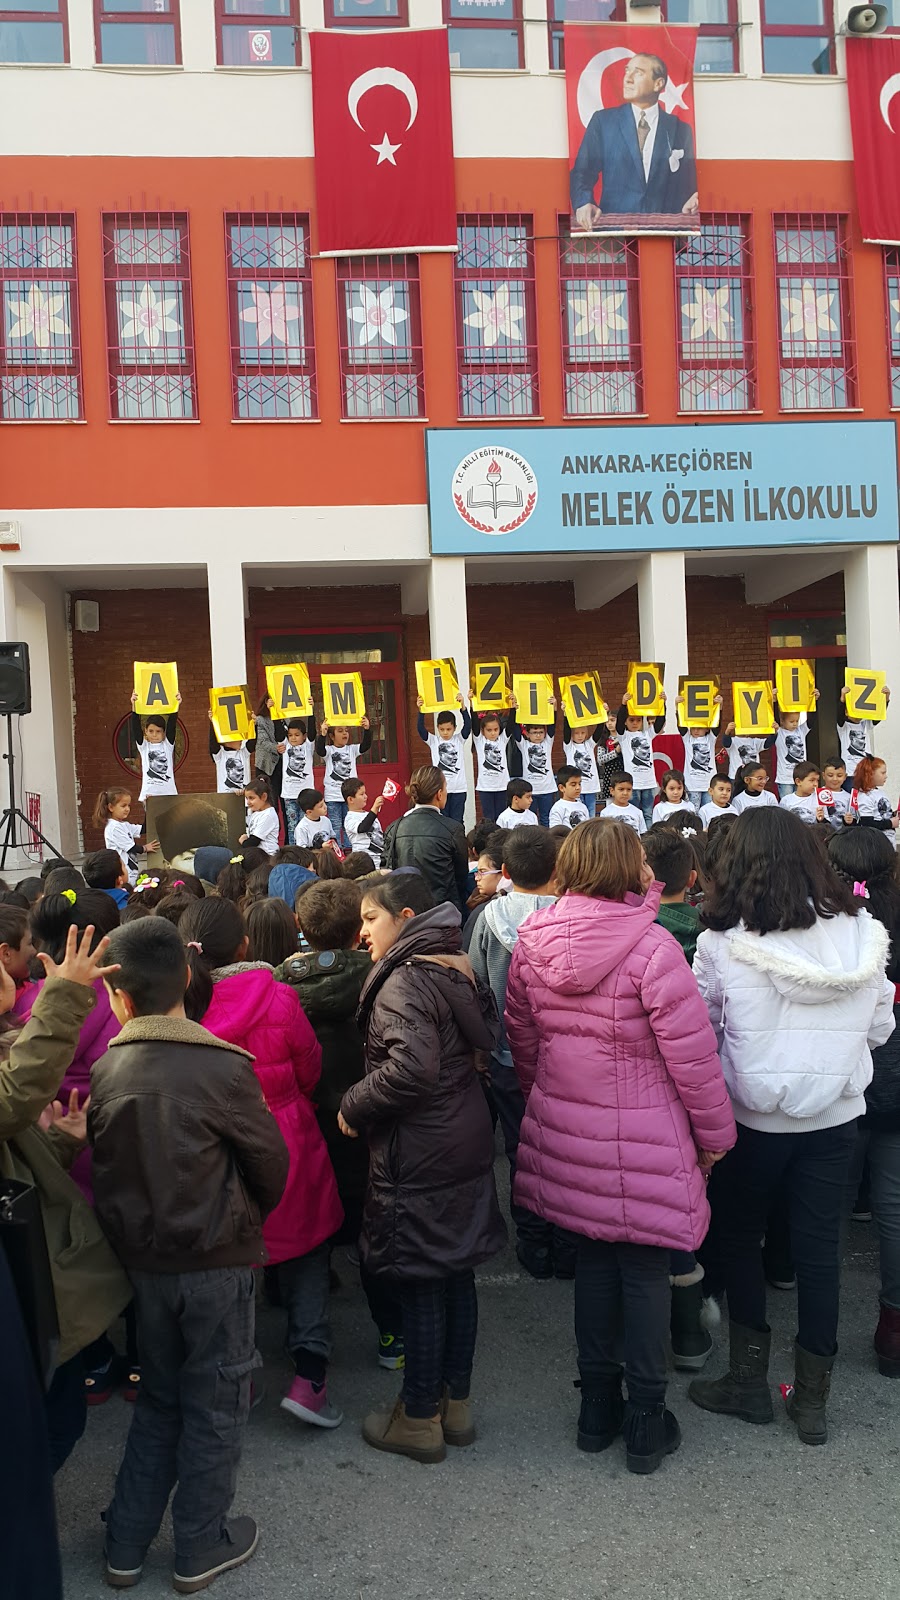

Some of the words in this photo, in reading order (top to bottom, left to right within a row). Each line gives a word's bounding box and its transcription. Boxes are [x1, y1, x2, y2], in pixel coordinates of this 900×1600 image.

[455, 471, 465, 484] T.C.
[479, 447, 504, 458] EĞİTİM
[504, 451, 534, 484] BAKANLIĞI
[561, 448, 753, 477] ANKARA-KEÇİÖREN
[561, 491, 654, 526] MELEK
[662, 482, 736, 524] ÖZEN
[743, 479, 878, 522] İLKOKULU
[145, 672, 169, 706] A
[218, 694, 243, 732] T
[280, 674, 303, 709] A
[329, 681, 357, 715] M
[479, 665, 503, 701] Z
[569, 680, 599, 718] N
[636, 671, 657, 706] D
[687, 684, 710, 718] E
[742, 690, 763, 725] Y
[854, 677, 877, 711] Z
